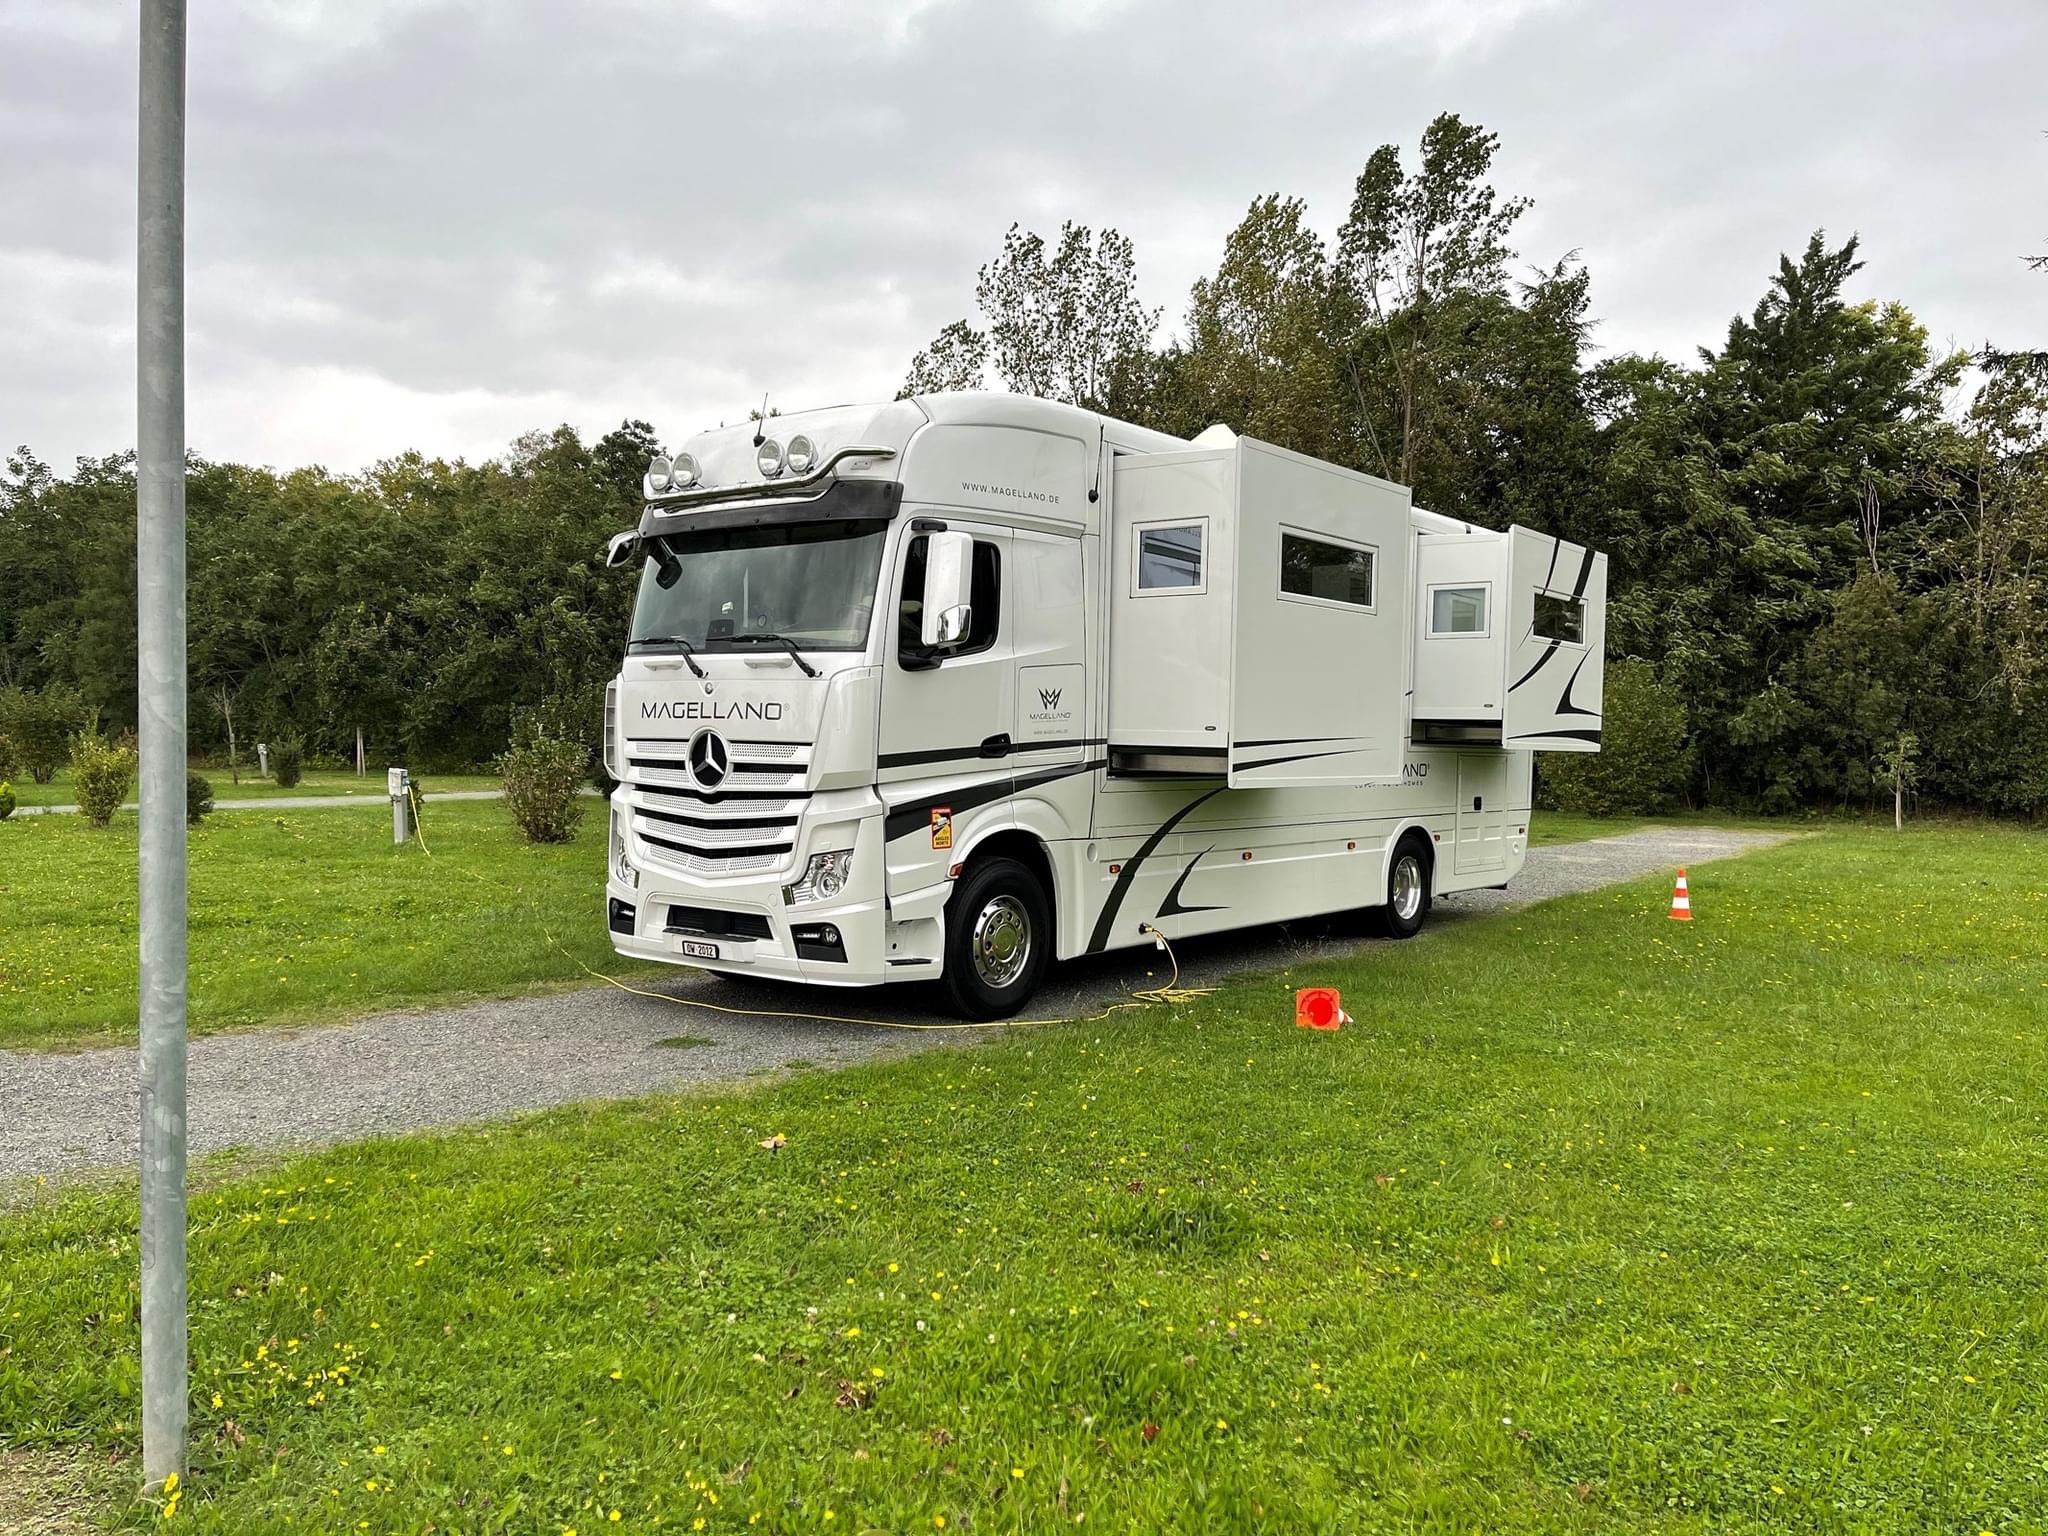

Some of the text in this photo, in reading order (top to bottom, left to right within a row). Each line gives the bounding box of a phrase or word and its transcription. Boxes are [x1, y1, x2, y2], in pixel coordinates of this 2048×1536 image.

[961, 481, 1060, 504] WWW.MAGELLANO.DE
[641, 702, 782, 721] MAGELLANO
[1030, 712, 1071, 720] MAGELLANO
[697, 945, 713, 957] 2012
